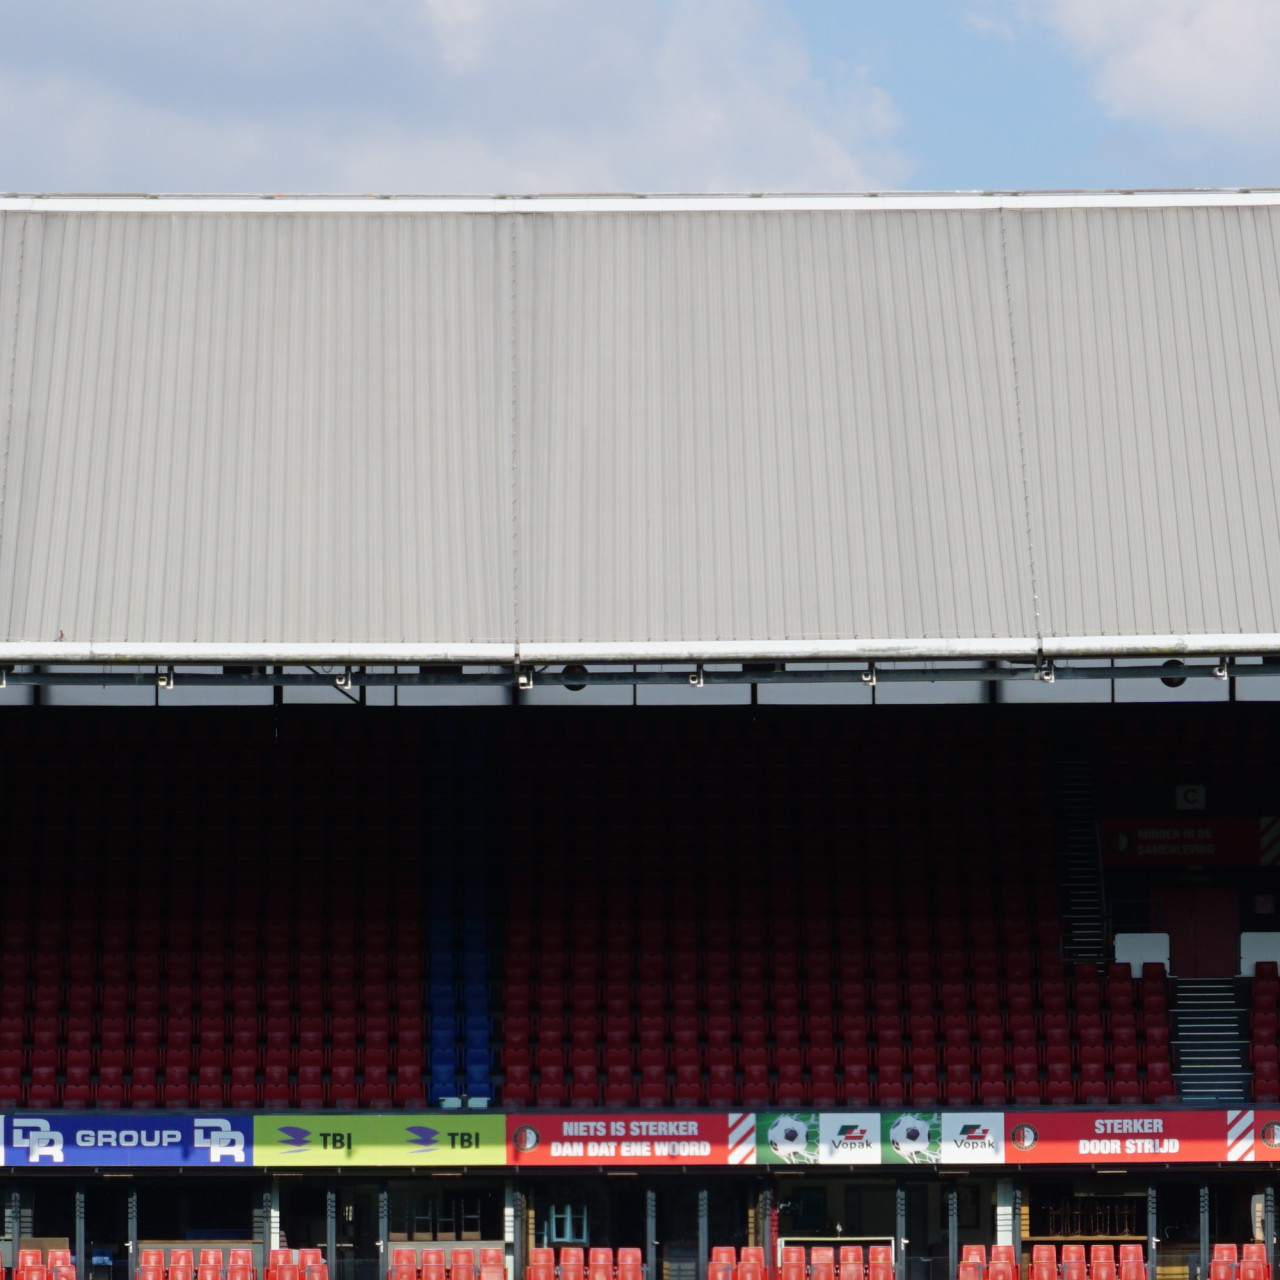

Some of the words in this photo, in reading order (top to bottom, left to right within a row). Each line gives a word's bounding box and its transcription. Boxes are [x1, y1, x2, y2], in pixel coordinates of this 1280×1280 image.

[1183, 788, 1198, 804] C
[1183, 829, 1195, 840] IN
[1198, 829, 1212, 840] DE
[563, 1121, 607, 1137] NIETS
[610, 1121, 627, 1136] IS
[629, 1120, 699, 1136] STERKER
[1094, 1118, 1163, 1134] STERKER
[75, 1130, 182, 1147] GROUP
[320, 1132, 352, 1151] TBI
[448, 1131, 480, 1150] TBI
[831, 1138, 873, 1152] Vopak
[954, 1138, 996, 1152] Vopak
[1079, 1139, 1121, 1154] DOOR
[1125, 1139, 1180, 1154] STRIJD
[551, 1142, 584, 1157] DAN
[588, 1142, 618, 1157] DAT
[621, 1142, 651, 1157] ENE
[654, 1141, 711, 1156] WOORD
